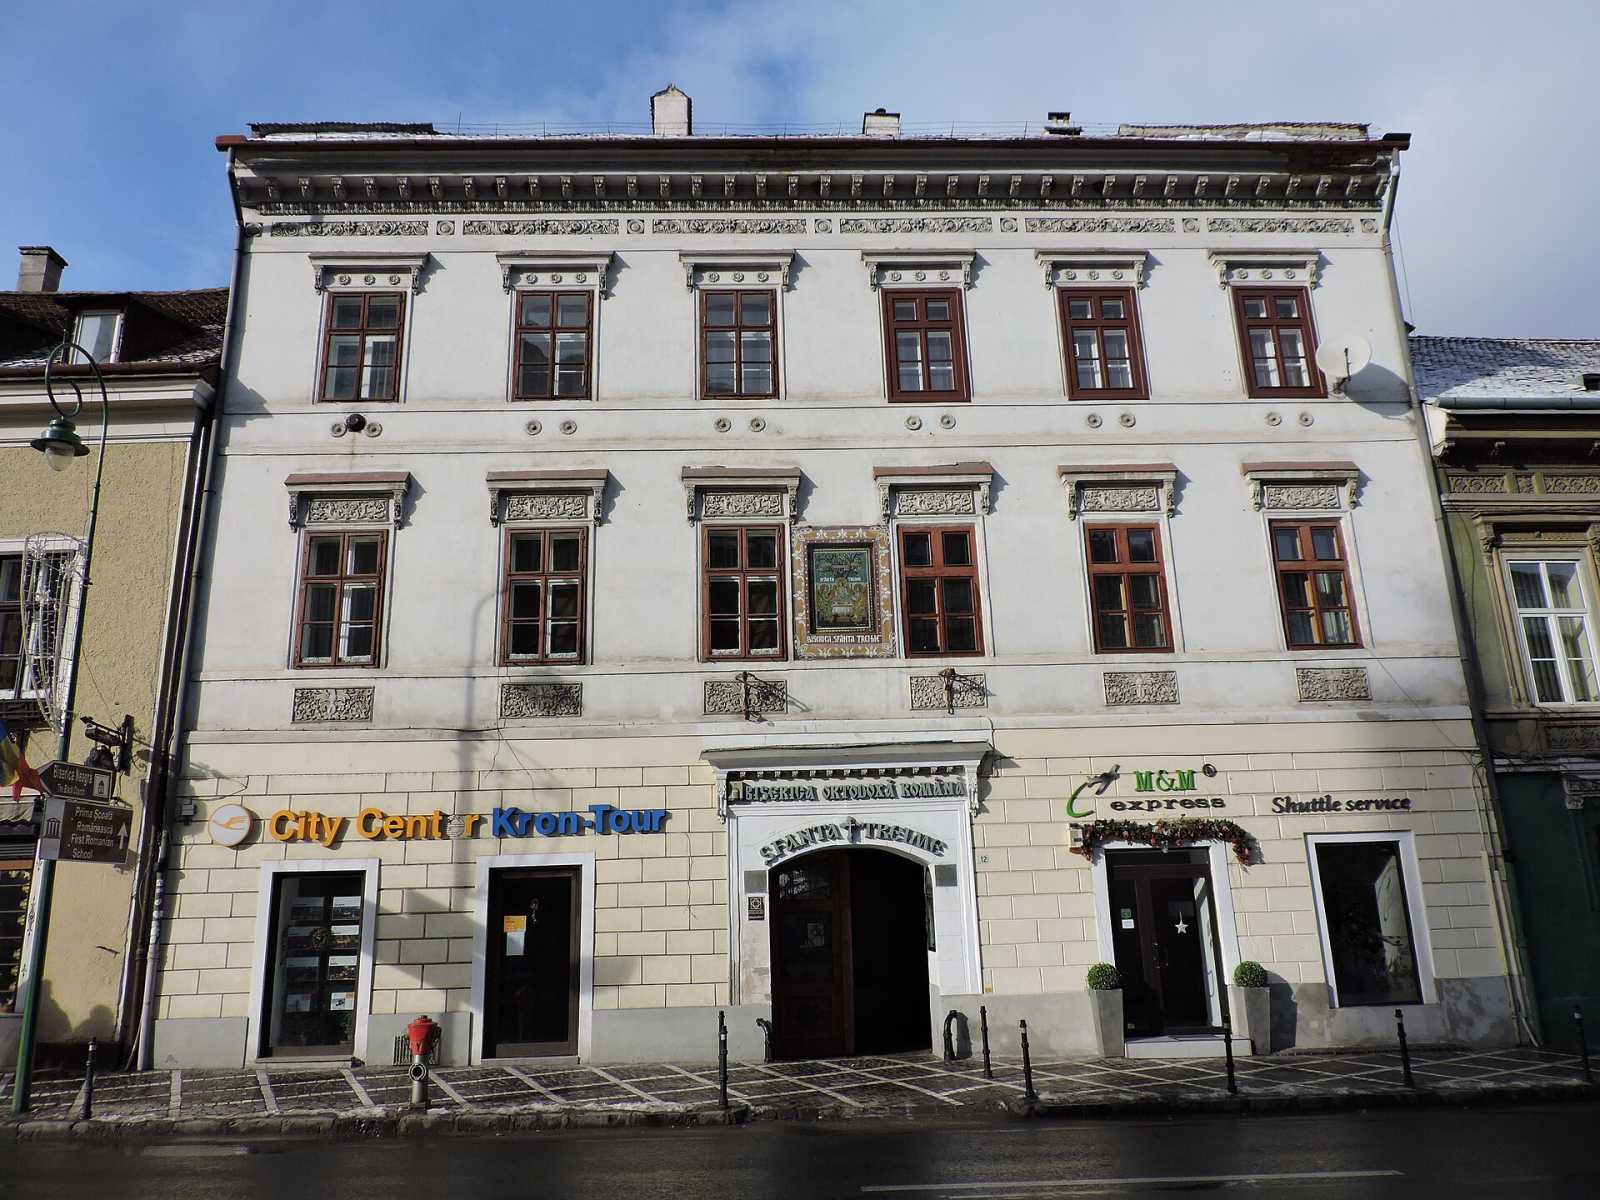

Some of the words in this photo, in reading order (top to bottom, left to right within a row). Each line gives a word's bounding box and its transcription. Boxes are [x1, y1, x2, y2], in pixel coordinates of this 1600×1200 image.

[1134, 769, 1197, 792] M&M
[745, 784, 816, 800] BISERICA
[1110, 797, 1227, 812] express
[1271, 795, 1343, 814] Shuttle
[1345, 796, 1414, 811] service
[268, 809, 346, 848] City
[357, 807, 483, 840] Centr
[491, 803, 668, 838] Kron-Tour
[864, 823, 950, 857] TREIME
[72, 847, 94, 859] School
